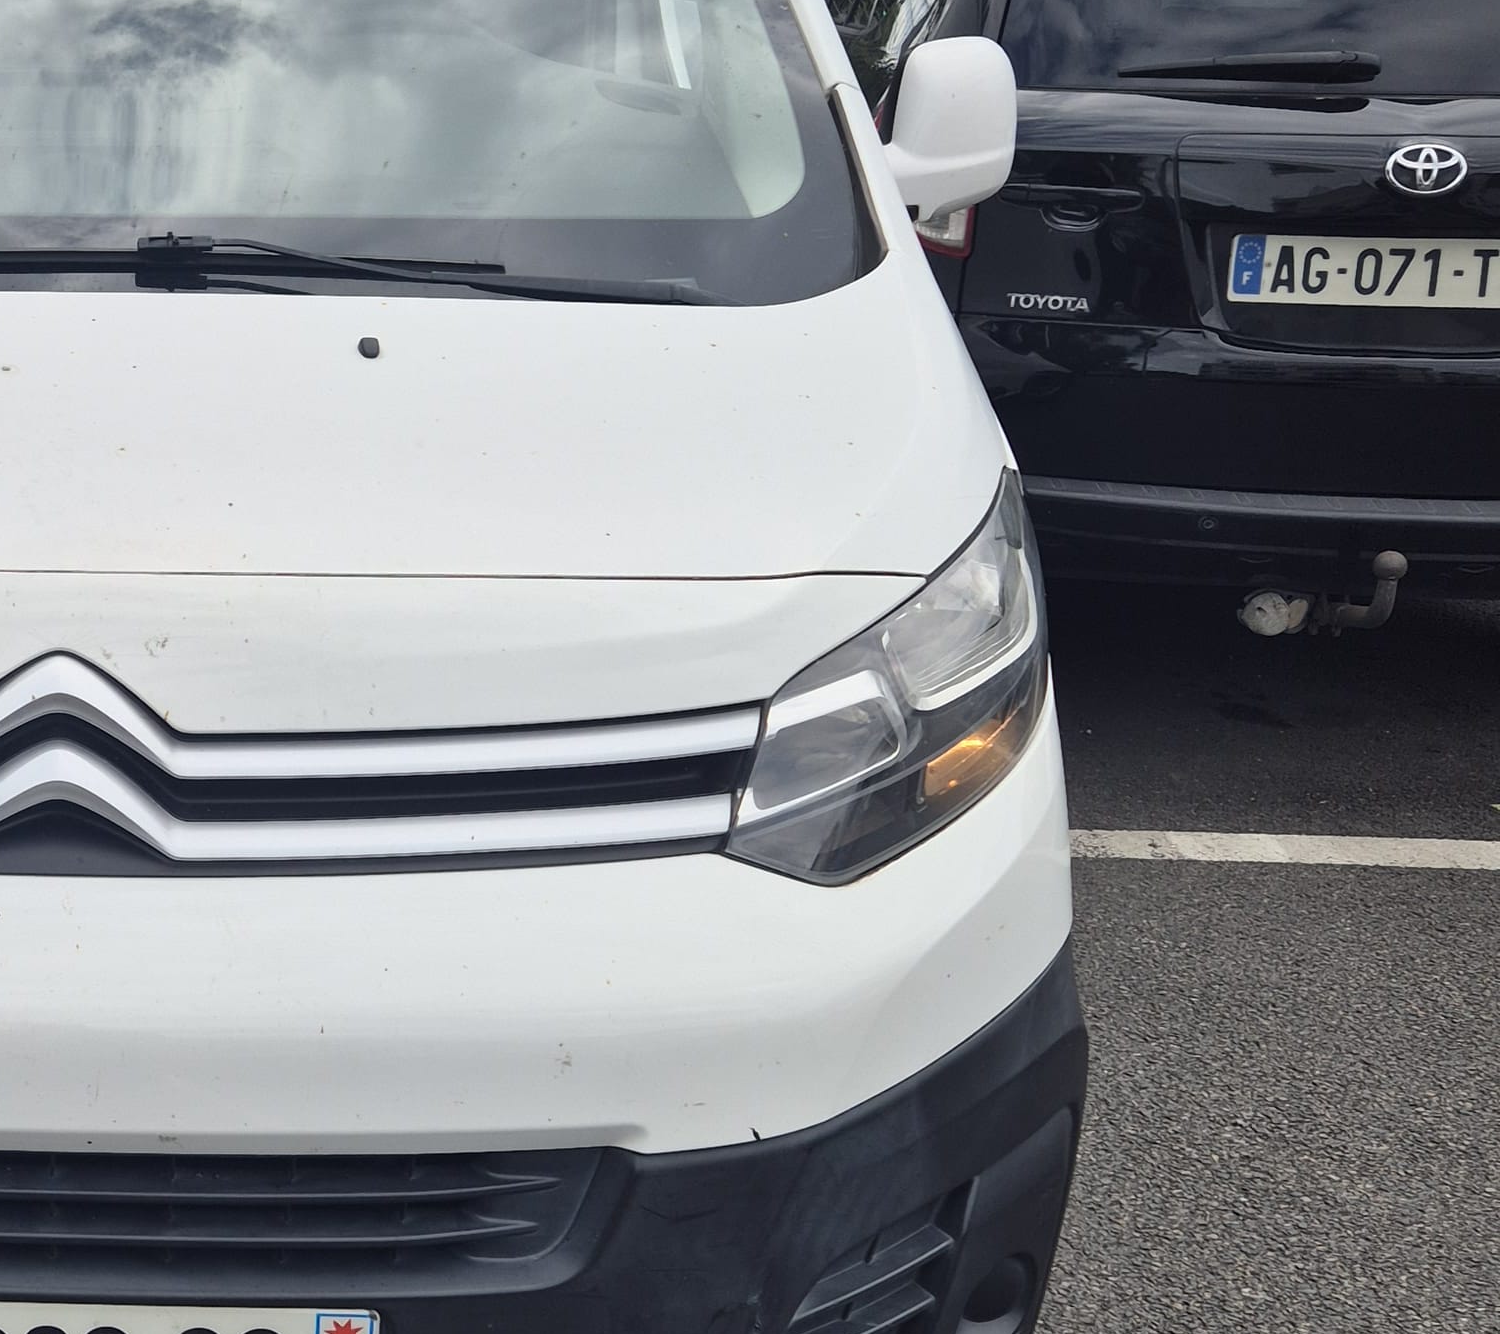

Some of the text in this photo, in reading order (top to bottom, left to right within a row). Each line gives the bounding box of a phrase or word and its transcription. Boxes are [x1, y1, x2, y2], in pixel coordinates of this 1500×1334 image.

[1240, 271, 1252, 285] F
[1270, 245, 1500, 297] AG-071-T
[1006, 292, 1090, 313] TOYOTA
